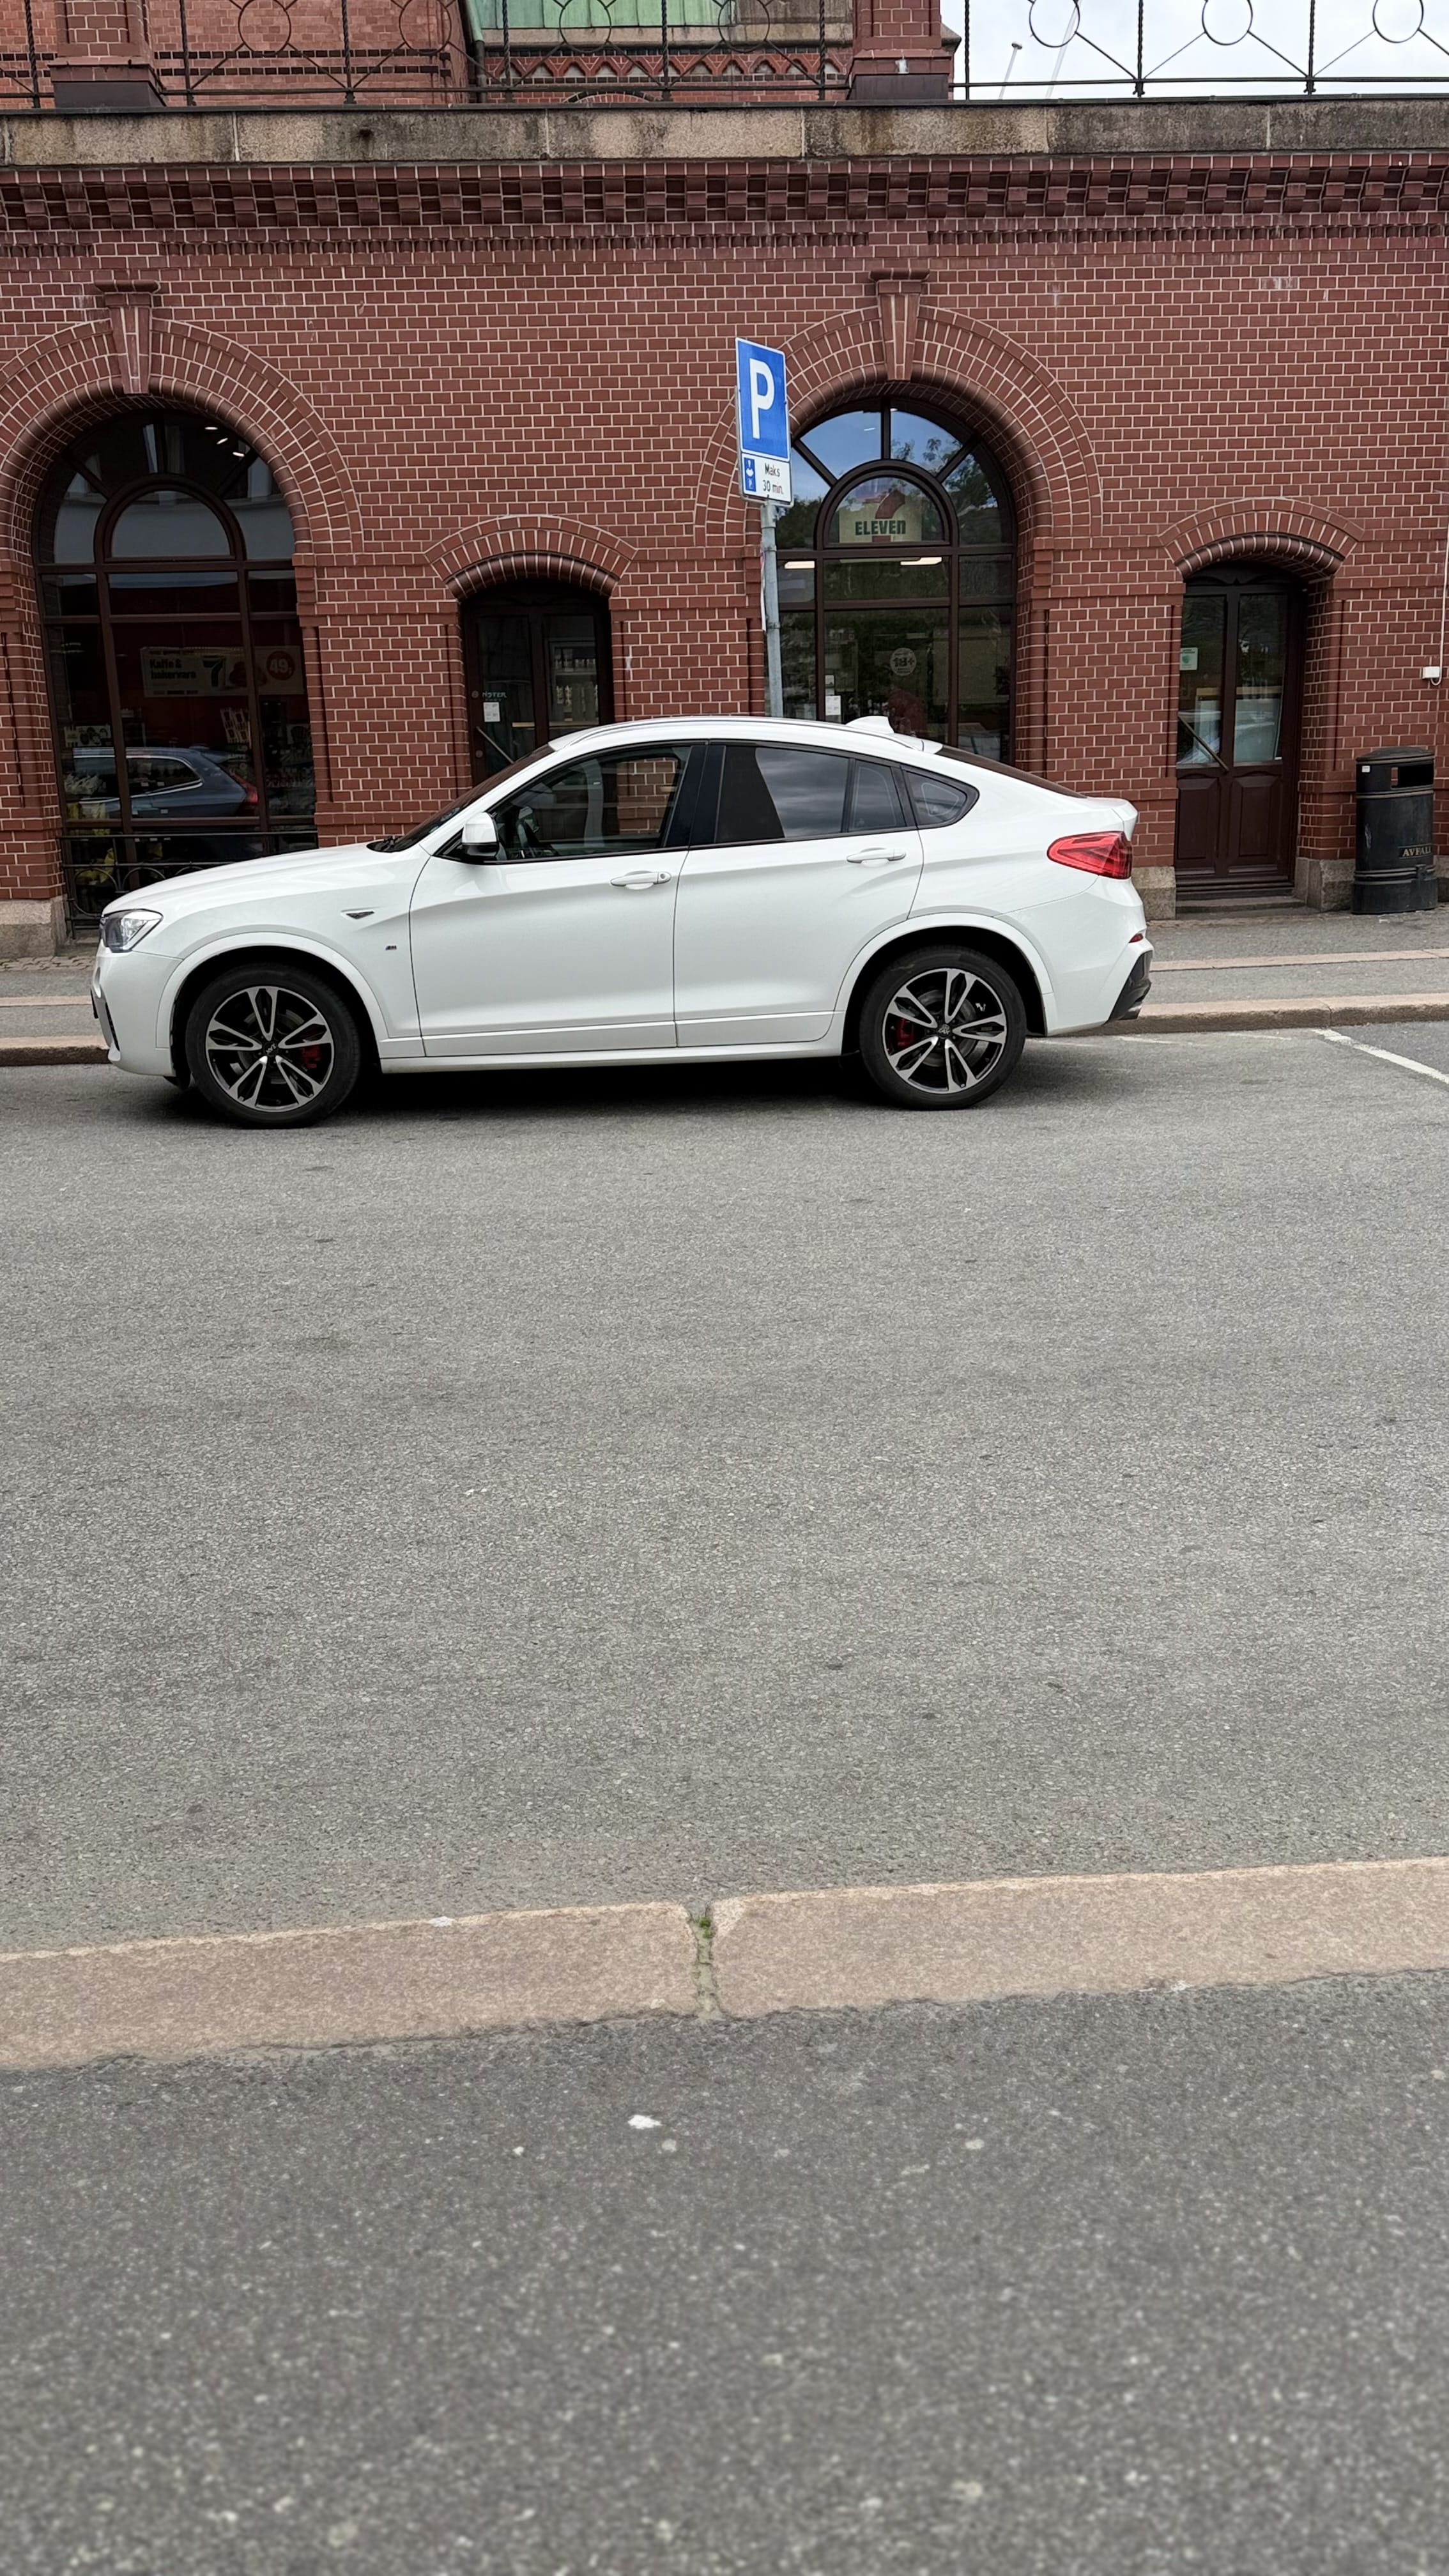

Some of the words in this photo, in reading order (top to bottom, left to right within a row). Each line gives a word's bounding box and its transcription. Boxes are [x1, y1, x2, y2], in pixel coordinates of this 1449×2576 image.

[749, 358, 774, 439] P
[765, 463, 781, 477] Maks
[763, 479, 770, 492] 30
[150, 659, 174, 668] Kaffe
[175, 659, 182, 668] &
